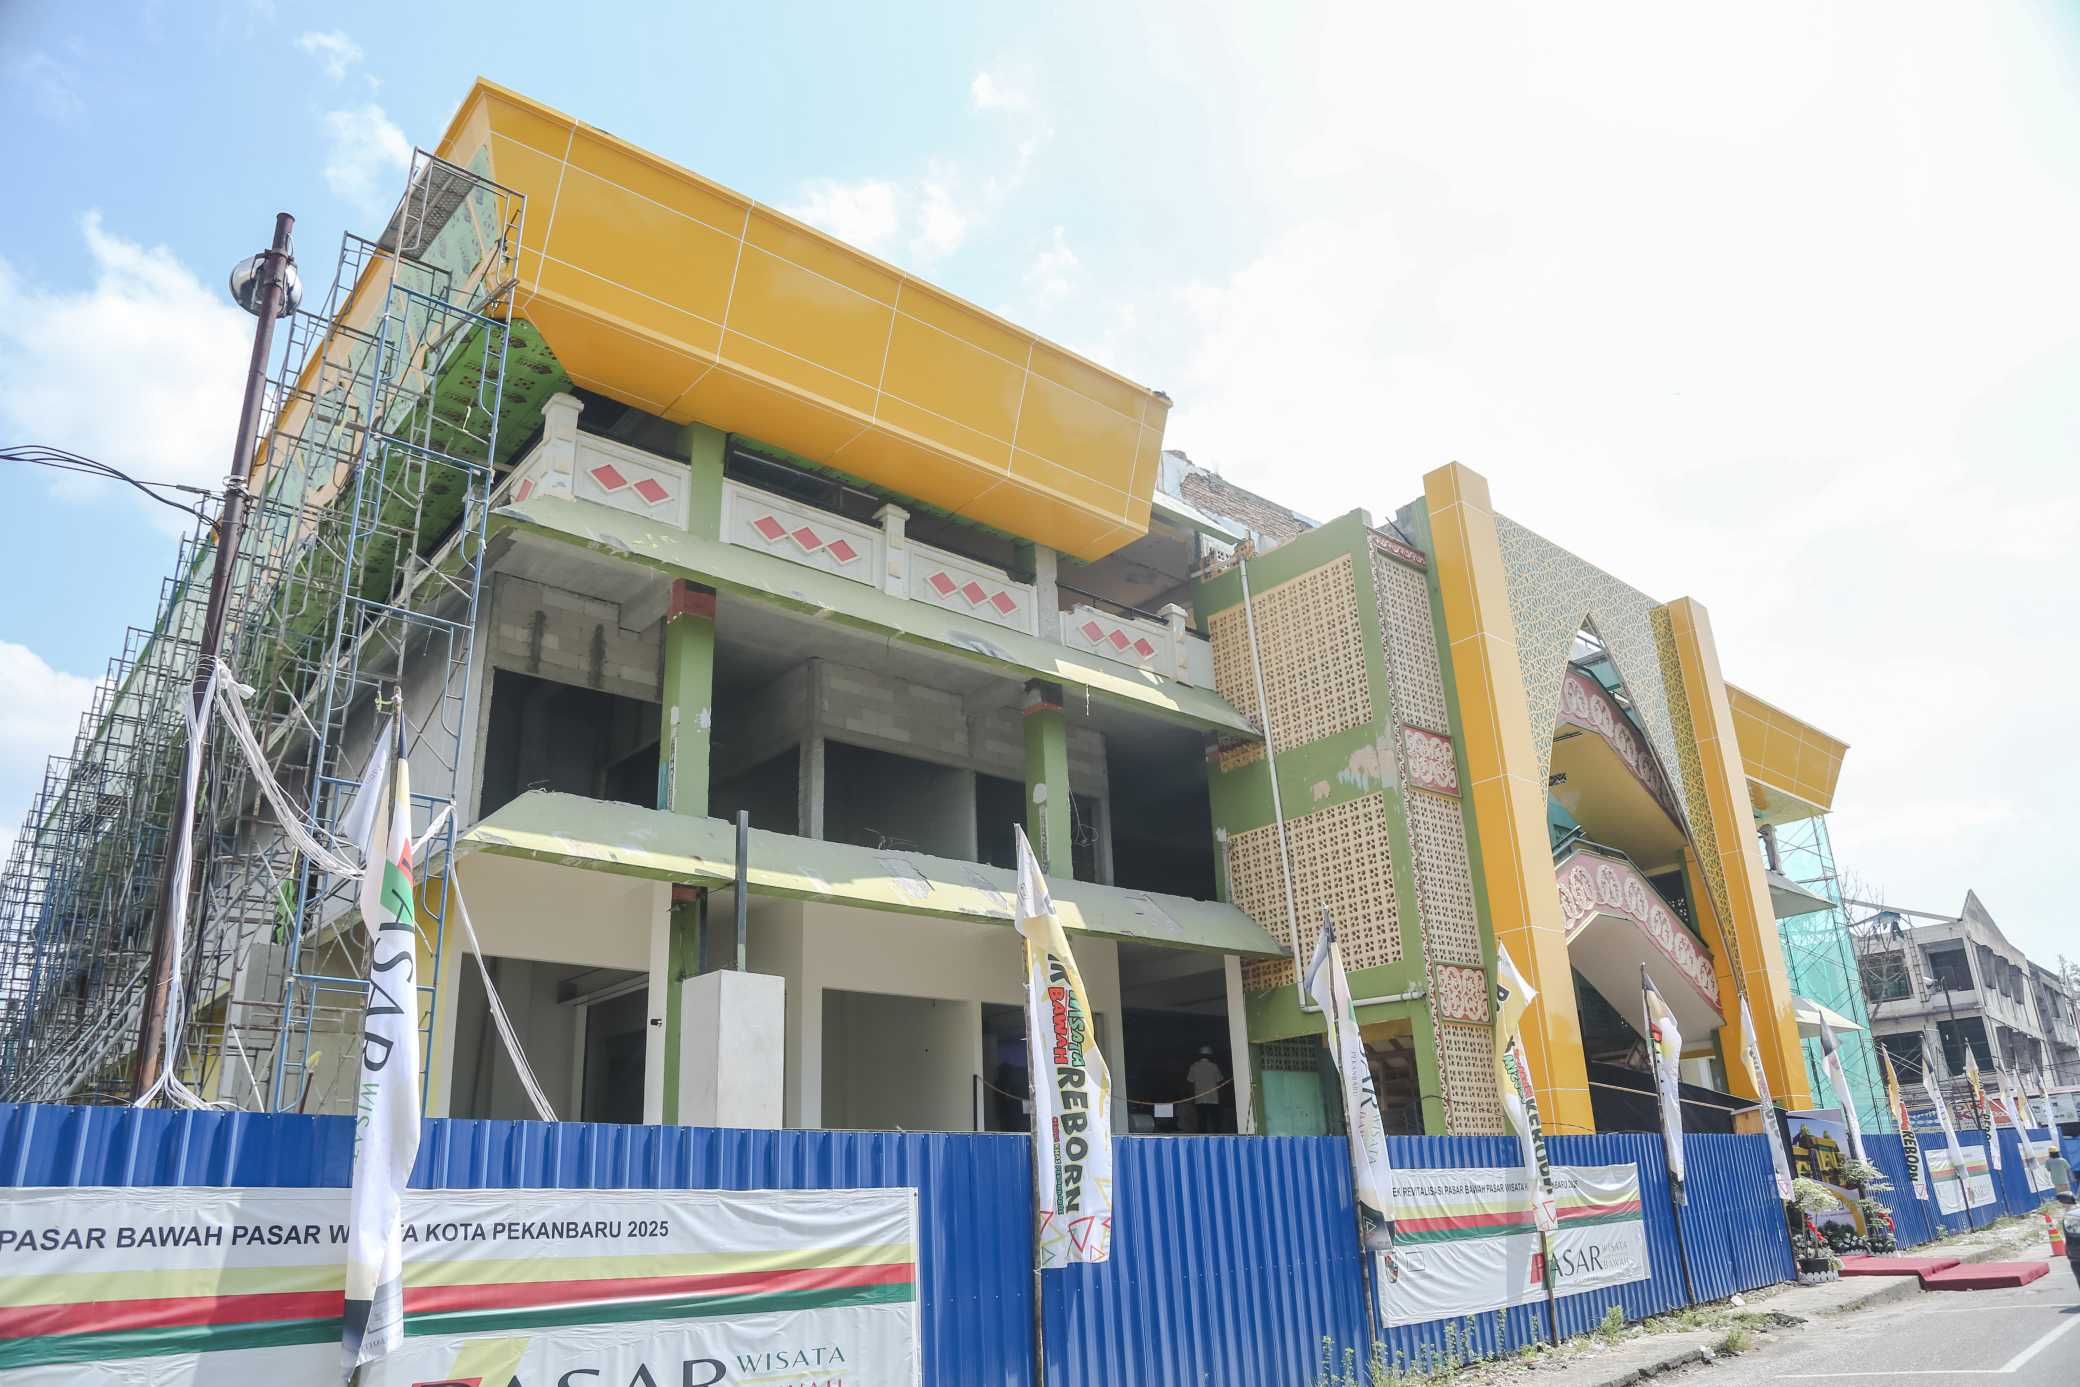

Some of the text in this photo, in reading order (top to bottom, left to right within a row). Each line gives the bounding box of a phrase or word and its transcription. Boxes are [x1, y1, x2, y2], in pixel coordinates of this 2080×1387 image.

[1048, 987, 1068, 1065] BAWAH
[1057, 1067, 1088, 1214] REBORN
[1445, 1185, 1463, 1196] PASAR
[1465, 1184, 1485, 1194] BAWAH
[1486, 1184, 1505, 1193] PASAR
[0, 1228, 107, 1252] PASAR
[116, 1225, 223, 1249] BAWAH
[231, 1224, 321, 1246] PASAR
[424, 1223, 486, 1242] KOTA
[492, 1221, 622, 1241] PEKANBARU
[627, 1220, 669, 1238] 2025
[736, 1346, 846, 1373] WISATA
